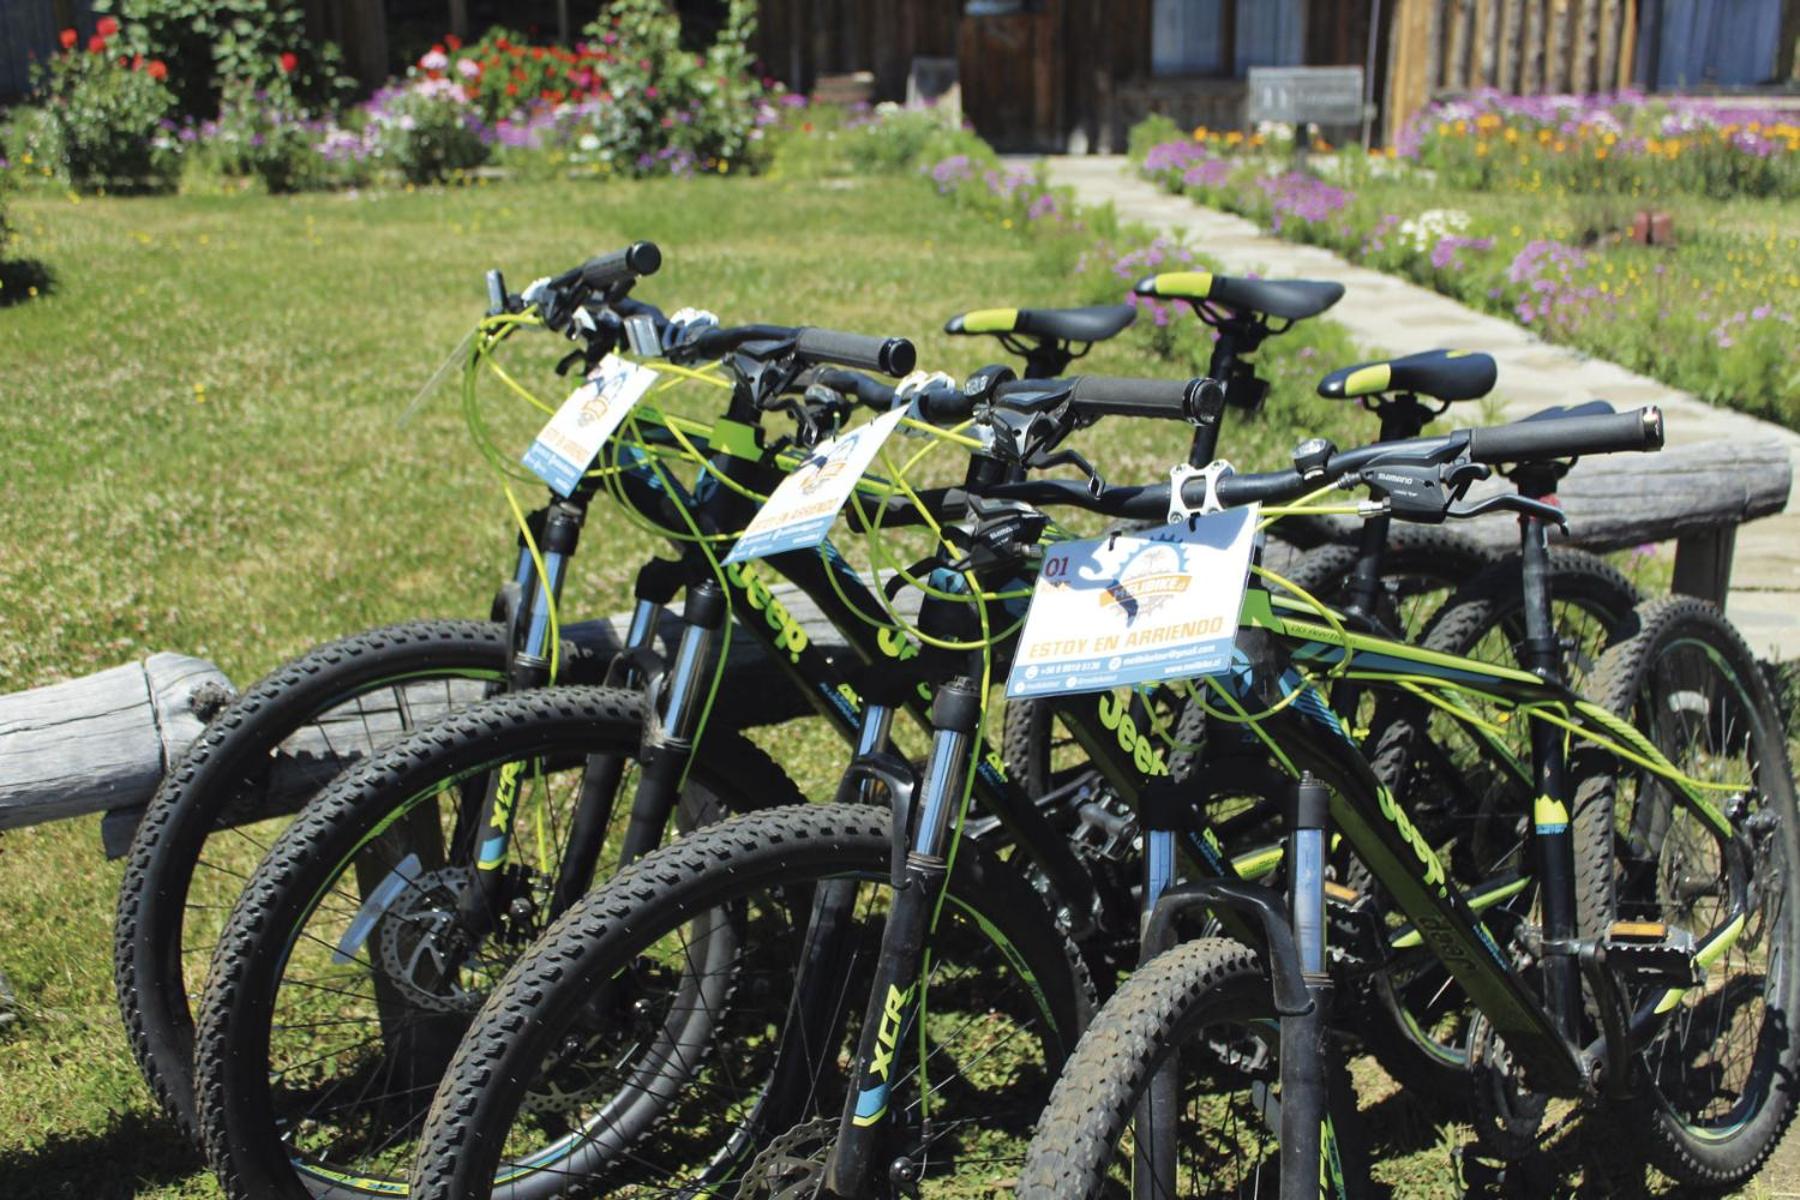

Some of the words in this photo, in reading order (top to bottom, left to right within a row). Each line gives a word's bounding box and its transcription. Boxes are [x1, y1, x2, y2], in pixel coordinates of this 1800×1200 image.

[1044, 556, 1070, 578] 01
[1028, 638, 1089, 660] ESTOY
[1092, 633, 1119, 653] EN
[1125, 616, 1225, 649] ARRIENDO
[490, 761, 520, 834] XCR
[869, 983, 908, 1083] XCR
